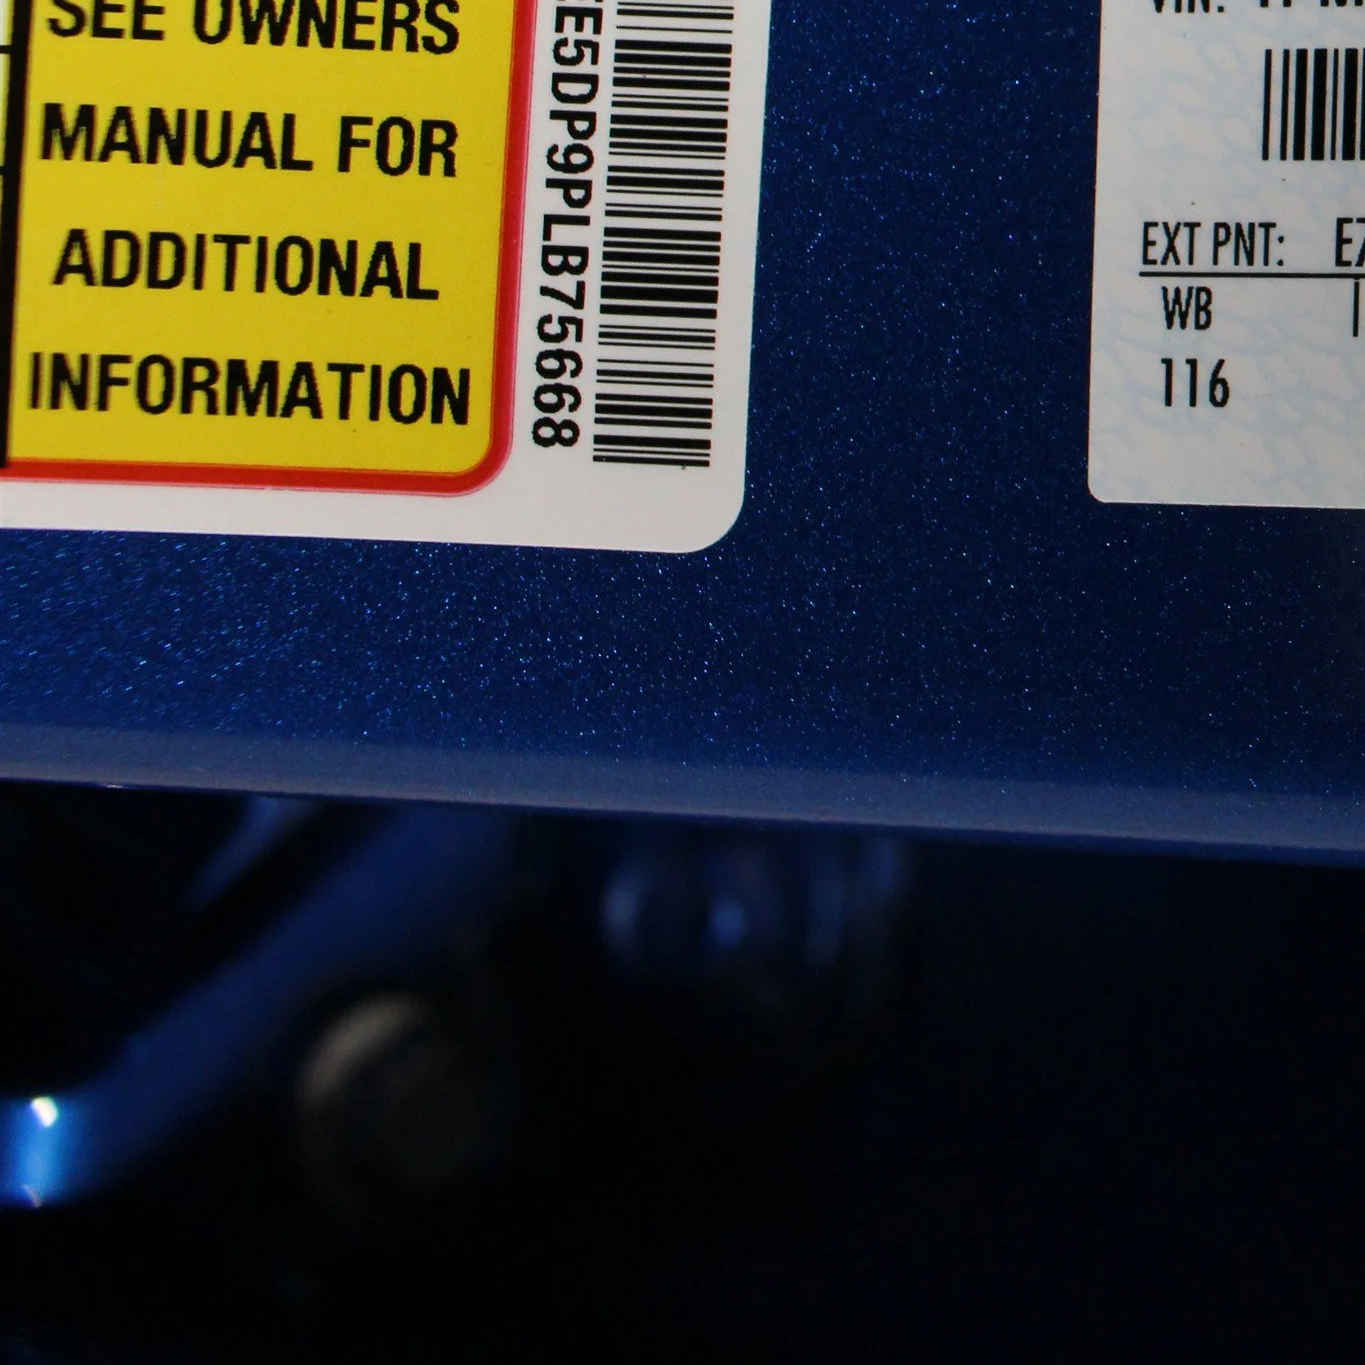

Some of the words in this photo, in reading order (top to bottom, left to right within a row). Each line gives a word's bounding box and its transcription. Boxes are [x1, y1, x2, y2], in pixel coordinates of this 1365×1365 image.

[41, 103, 313, 171] MANUAL
[337, 116, 457, 177] FOR
[53, 229, 439, 300] ADDITIONAL
[1142, 222, 1201, 265] EXT
[1213, 222, 1284, 266] PNT:
[1162, 286, 1212, 330] WB
[30, 352, 470, 425] INFORMATION
[1161, 358, 1229, 408] 116
